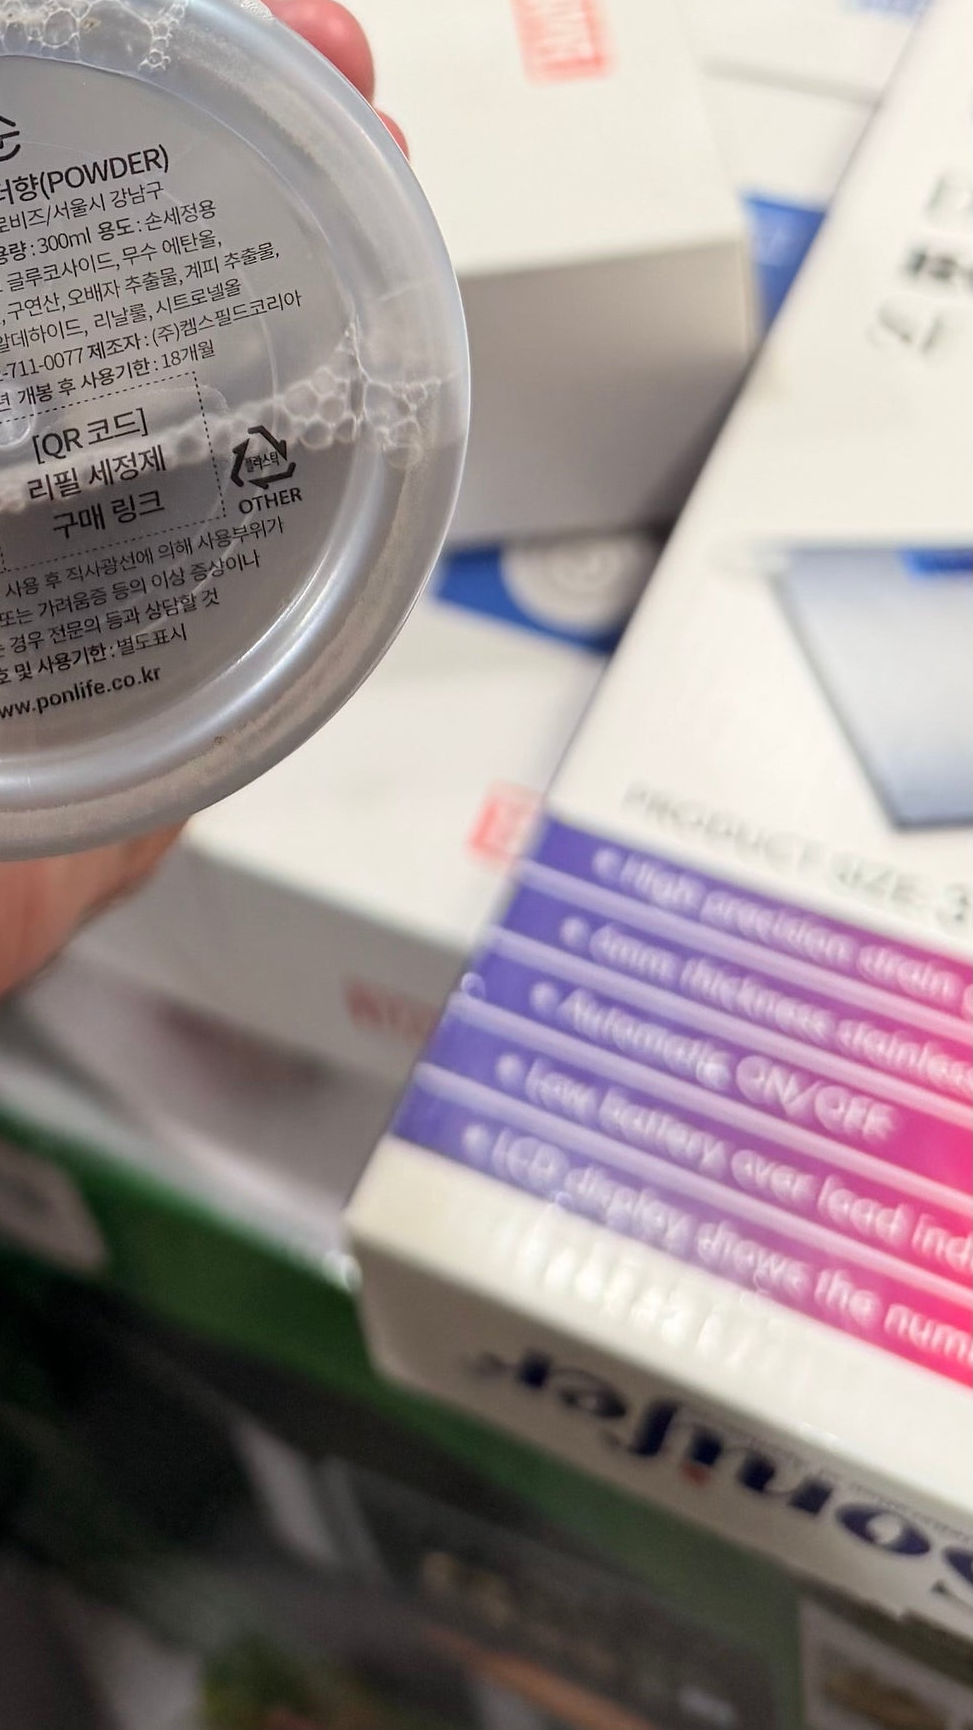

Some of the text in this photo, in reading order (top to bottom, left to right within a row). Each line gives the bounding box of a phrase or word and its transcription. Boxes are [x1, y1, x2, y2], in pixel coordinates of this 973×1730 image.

[109, 180, 164, 209] 강남구
[36, 226, 92, 254] 300ml
[97, 217, 136, 242] 용도
[144, 199, 217, 232] 손세정용
[6, 251, 121, 292] 글루코사이드,
[122, 242, 158, 266] 무수
[161, 229, 222, 255] 에탄올,
[7, 291, 66, 321] 구연산,
[67, 279, 121, 307] 오배자
[124, 266, 184, 295] 추출물,
[184, 255, 220, 279] 계피
[223, 241, 280, 270] 추출물,
[93, 302, 153, 330] 리날룰,
[155, 278, 242, 315] 시트로넬올
[17, 382, 54, 405] 개봉
[57, 377, 77, 397] 후
[80, 357, 151, 389] 사용기한
[161, 338, 216, 369] 18개월
[86, 332, 141, 360] 제조자
[31, 406, 149, 465] [QR 코드]
[26, 444, 167, 502] 리필 세정제
[238, 487, 303, 515] OTHER
[52, 490, 165, 539] 구매 링크
[5, 576, 39, 598] 사용
[44, 571, 62, 590] 후
[66, 547, 154, 582] 직사광선에
[157, 536, 193, 559] 의해
[197, 515, 284, 550] 사용부위가
[37, 588, 107, 618] 가려움증
[112, 576, 147, 601] 등의
[151, 566, 186, 590] 이상
[190, 549, 260, 582] 증상이나
[9, 631, 45, 654] 경우
[49, 615, 102, 645] 전문의
[106, 606, 140, 630] 등과
[145, 593, 198, 621] 상담할
[202, 587, 220, 608] 것
[14, 660, 33, 682] 및
[116, 622, 188, 657] 별도표시
[600, 1088, 729, 1175] battery
[732, 1150, 818, 1208] over
[819, 1174, 914, 1244] load
[912, 1213, 973, 1272] ind
[815, 1271, 881, 1328] the
[884, 1304, 973, 1364] num
